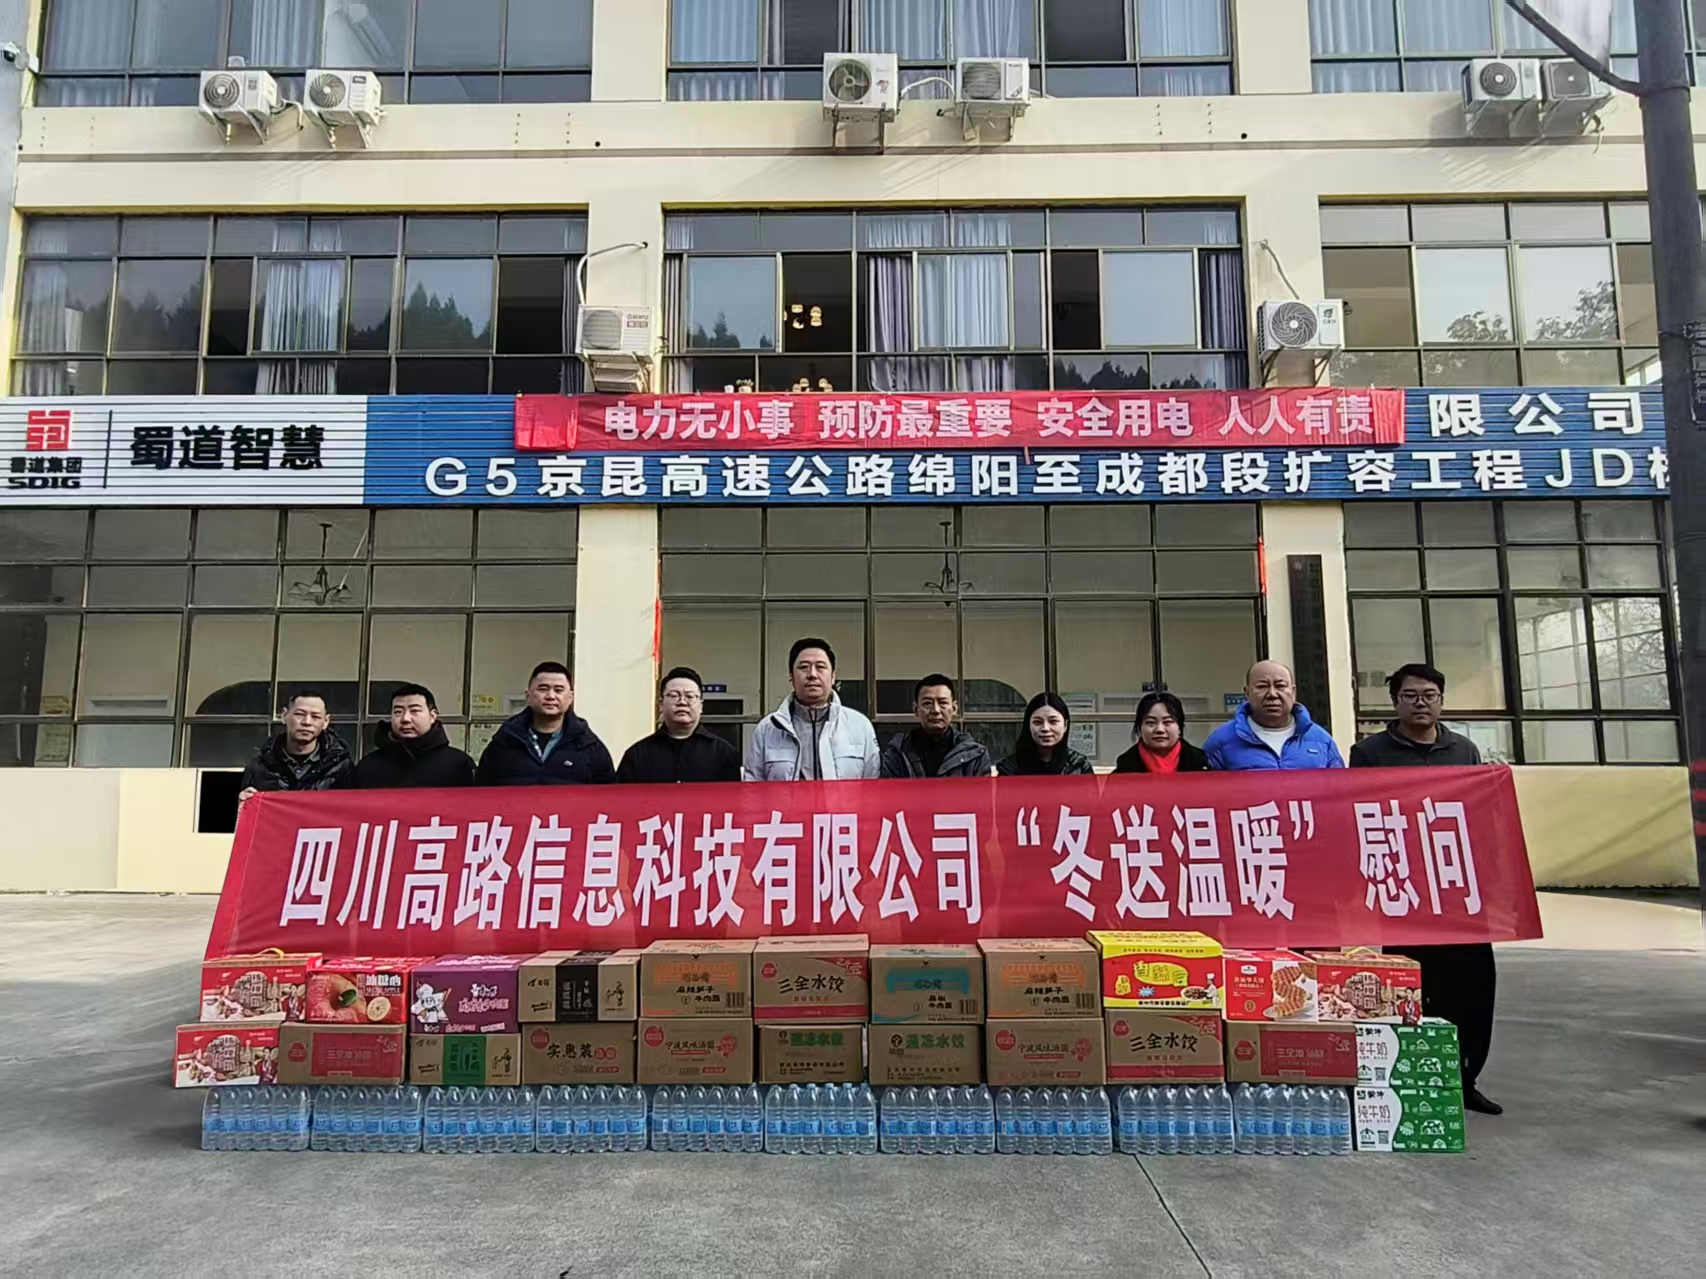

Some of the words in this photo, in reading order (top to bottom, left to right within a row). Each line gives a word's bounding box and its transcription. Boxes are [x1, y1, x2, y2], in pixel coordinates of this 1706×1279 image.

[604, 399, 795, 441] 电力无小事
[818, 398, 1012, 440] 预防最重要
[1036, 397, 1194, 438] 安全用电
[1217, 395, 1375, 436] 人人有责
[1429, 391, 1644, 437] 限公司
[129, 424, 325, 471] 蜀道智慧
[10, 457, 82, 473] 蜀道集团
[8, 477, 81, 489] SDIG
[278, 810, 982, 931] 四川高路信息科技有限公司
[1352, 796, 1482, 917] 慰问
[778, 973, 845, 994] 三全水饺
[547, 1042, 593, 1059] 实惠装
[1129, 1031, 1198, 1053] 三全水饺
[1358, 1105, 1390, 1119] 纯牛奶
